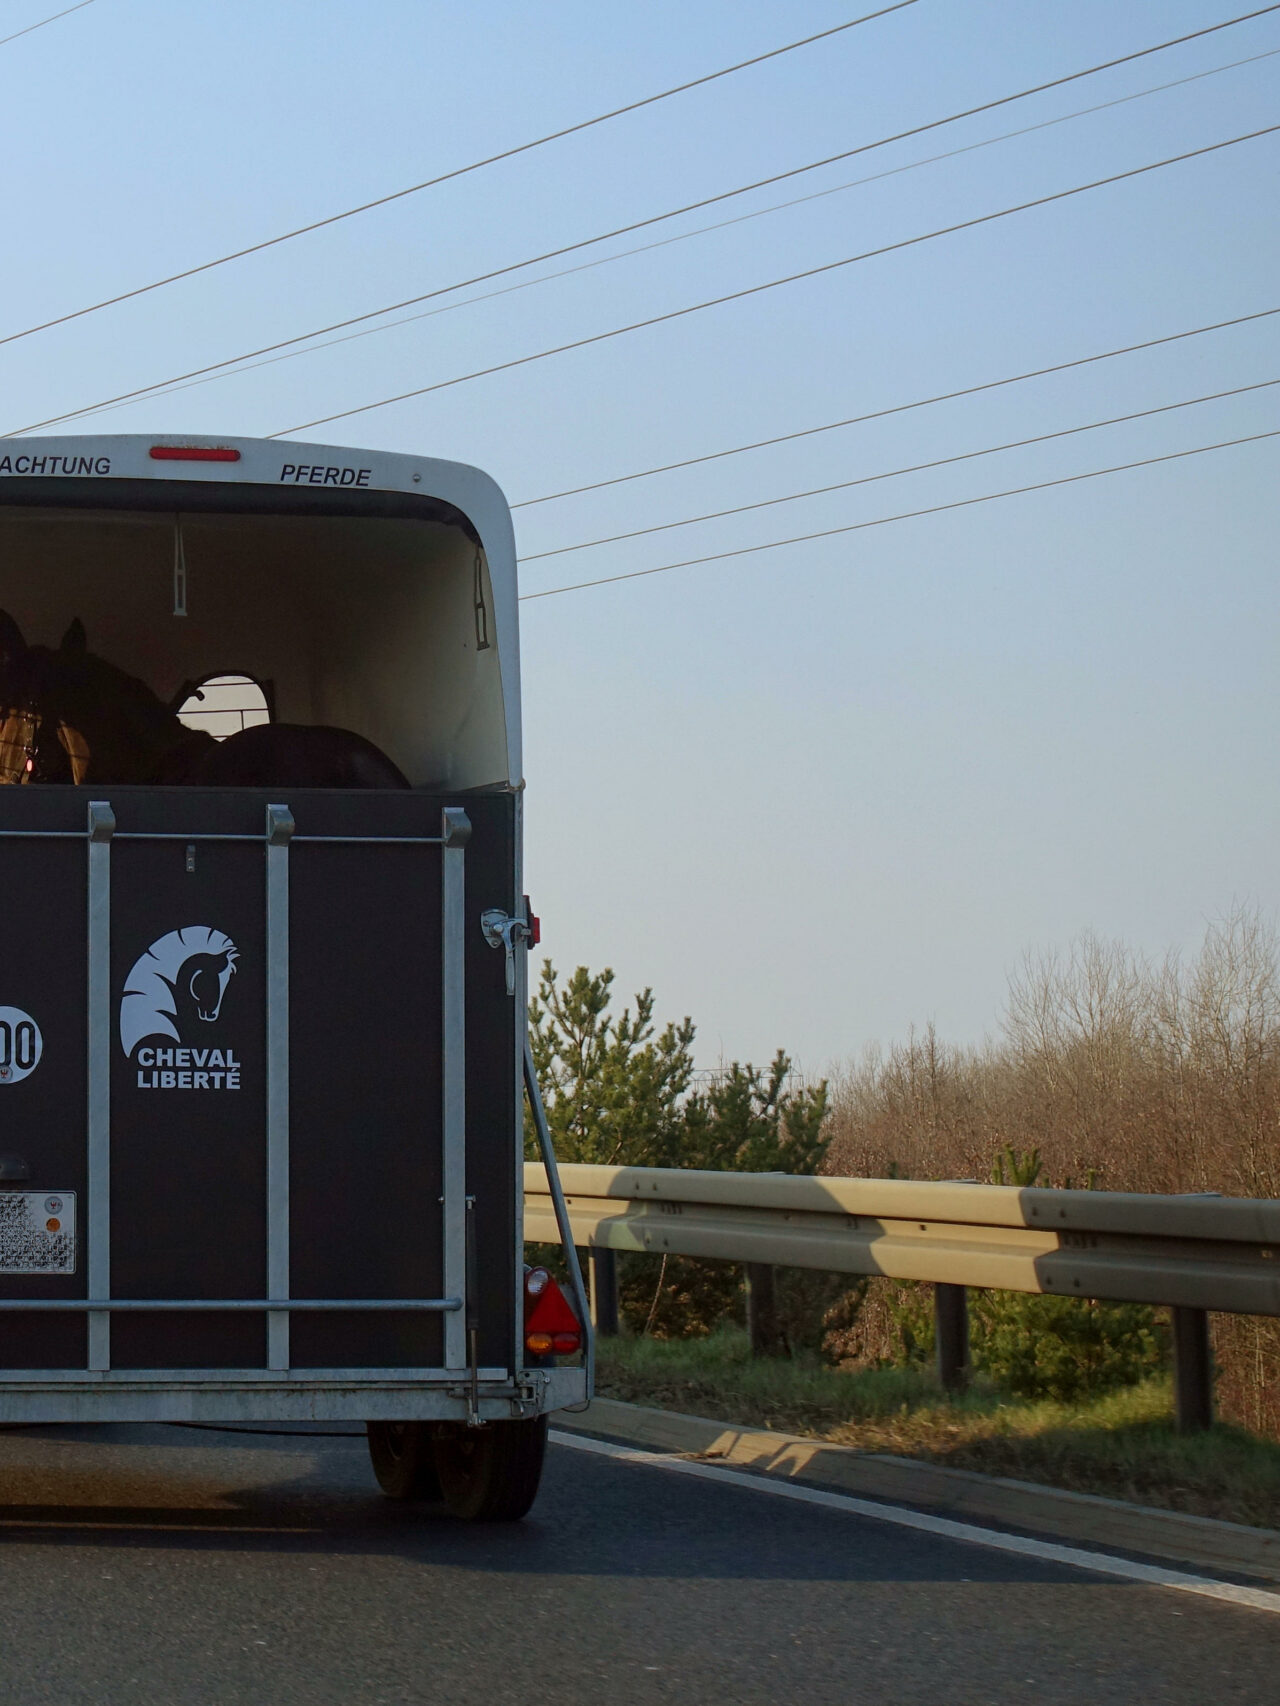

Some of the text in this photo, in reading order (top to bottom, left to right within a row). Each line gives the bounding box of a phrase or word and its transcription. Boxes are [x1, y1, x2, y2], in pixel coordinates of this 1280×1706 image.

[280, 464, 372, 487] PFERDE
[137, 1048, 241, 1068] CHEVAL
[137, 1068, 241, 1090] LIBERTÉ
